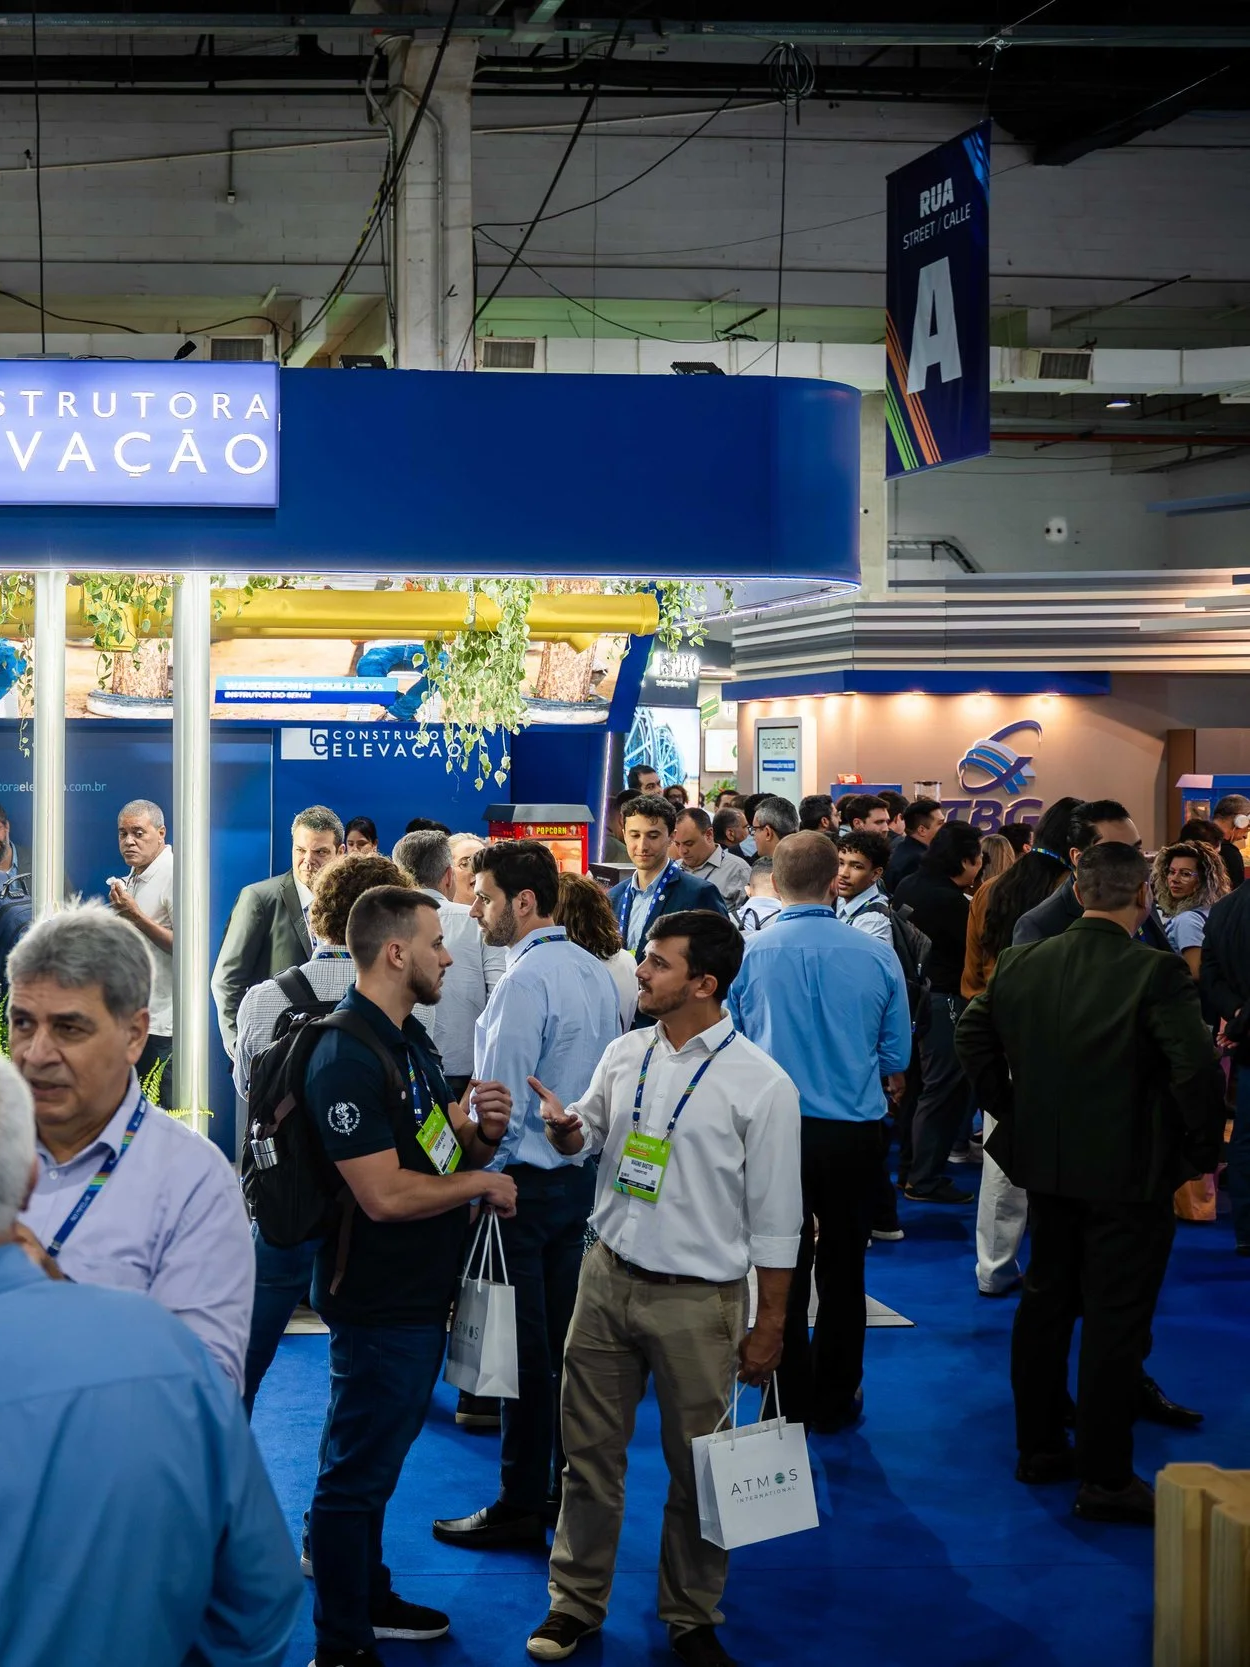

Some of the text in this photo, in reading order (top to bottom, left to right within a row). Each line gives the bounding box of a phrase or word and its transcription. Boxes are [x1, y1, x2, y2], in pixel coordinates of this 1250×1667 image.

[919, 178, 954, 218] RUA
[902, 221, 935, 250] STREET
[943, 203, 971, 231] CALLE
[907, 256, 962, 395] A
[333, 742, 461, 758] ELEVAÇÃO
[536, 827, 567, 835] POPCORN
[940, 798, 1044, 836] TBG
[736, 1486, 796, 1504] INTERNATIONAL
